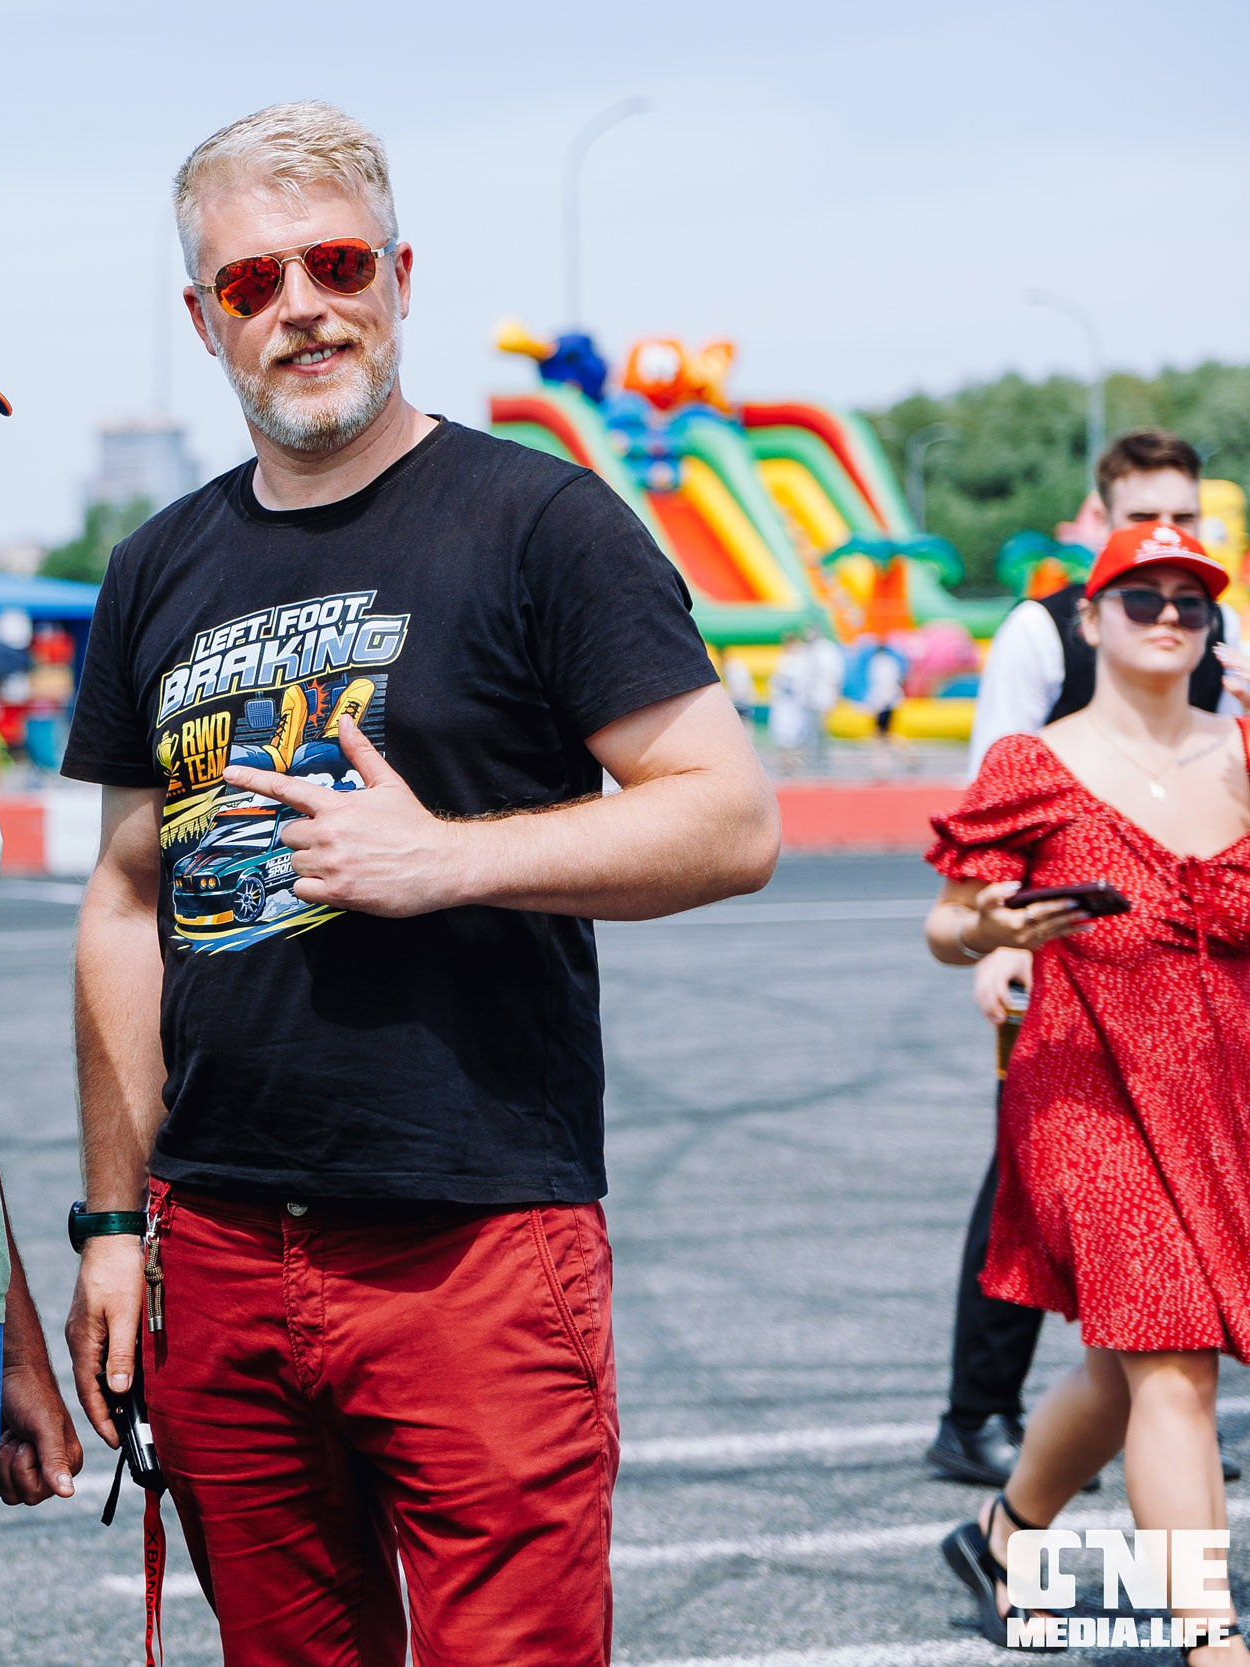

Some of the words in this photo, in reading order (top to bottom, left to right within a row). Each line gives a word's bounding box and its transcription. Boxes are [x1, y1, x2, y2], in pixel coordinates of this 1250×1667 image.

[194, 614, 268, 662] LEFT
[278, 597, 369, 635] FOOT
[159, 620, 403, 721] BRAKING
[182, 711, 231, 757] RWD
[184, 746, 228, 783] TEAM
